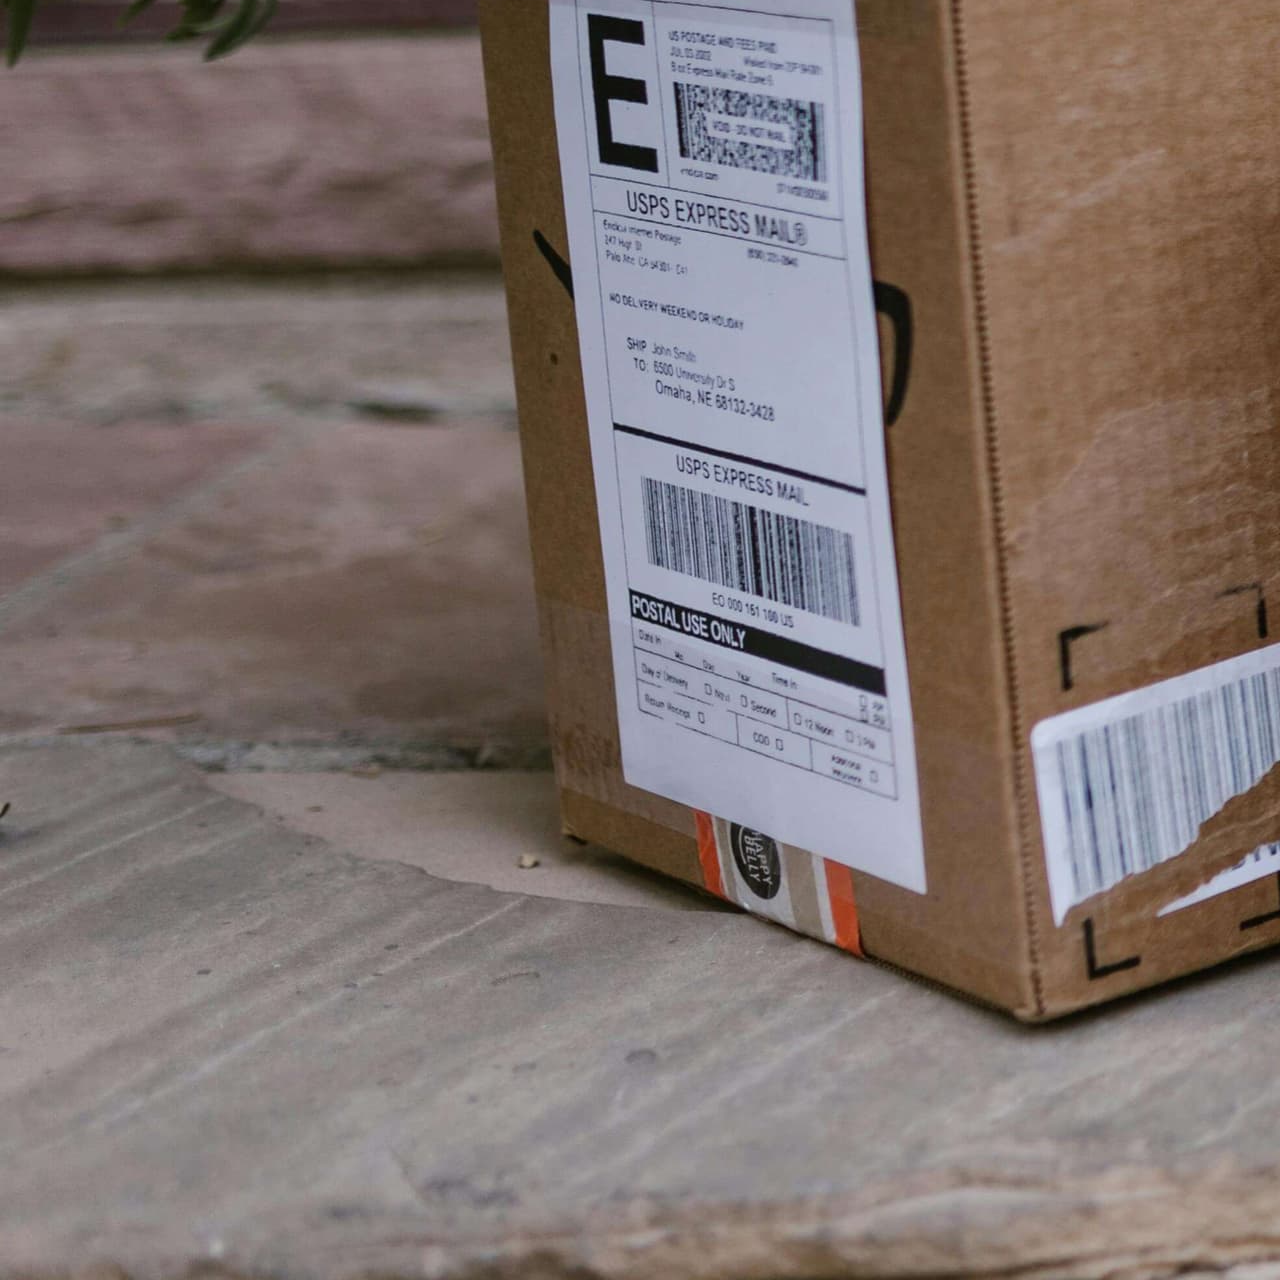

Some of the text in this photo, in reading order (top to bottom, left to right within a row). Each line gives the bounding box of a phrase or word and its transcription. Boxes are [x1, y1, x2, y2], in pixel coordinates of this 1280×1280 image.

[680, 31, 717, 46] POSTAGE
[587, 13, 659, 174] E
[626, 190, 670, 219] USPS
[675, 199, 750, 235] EXPRESS
[622, 296, 658, 312] DELIVERY
[660, 303, 698, 322] WEEKEND
[698, 311, 710, 324] OR
[626, 337, 647, 353] SHIP
[652, 342, 672, 357] John
[675, 367, 716, 390] University
[655, 379, 696, 405] Omaha,
[697, 389, 713, 407] NE
[676, 454, 811, 507] USPS EXPRESS MAIL
[728, 597, 743, 612] 000
[632, 595, 746, 649] POSTAL USE ONLY
[744, 835, 762, 883] BELLY
